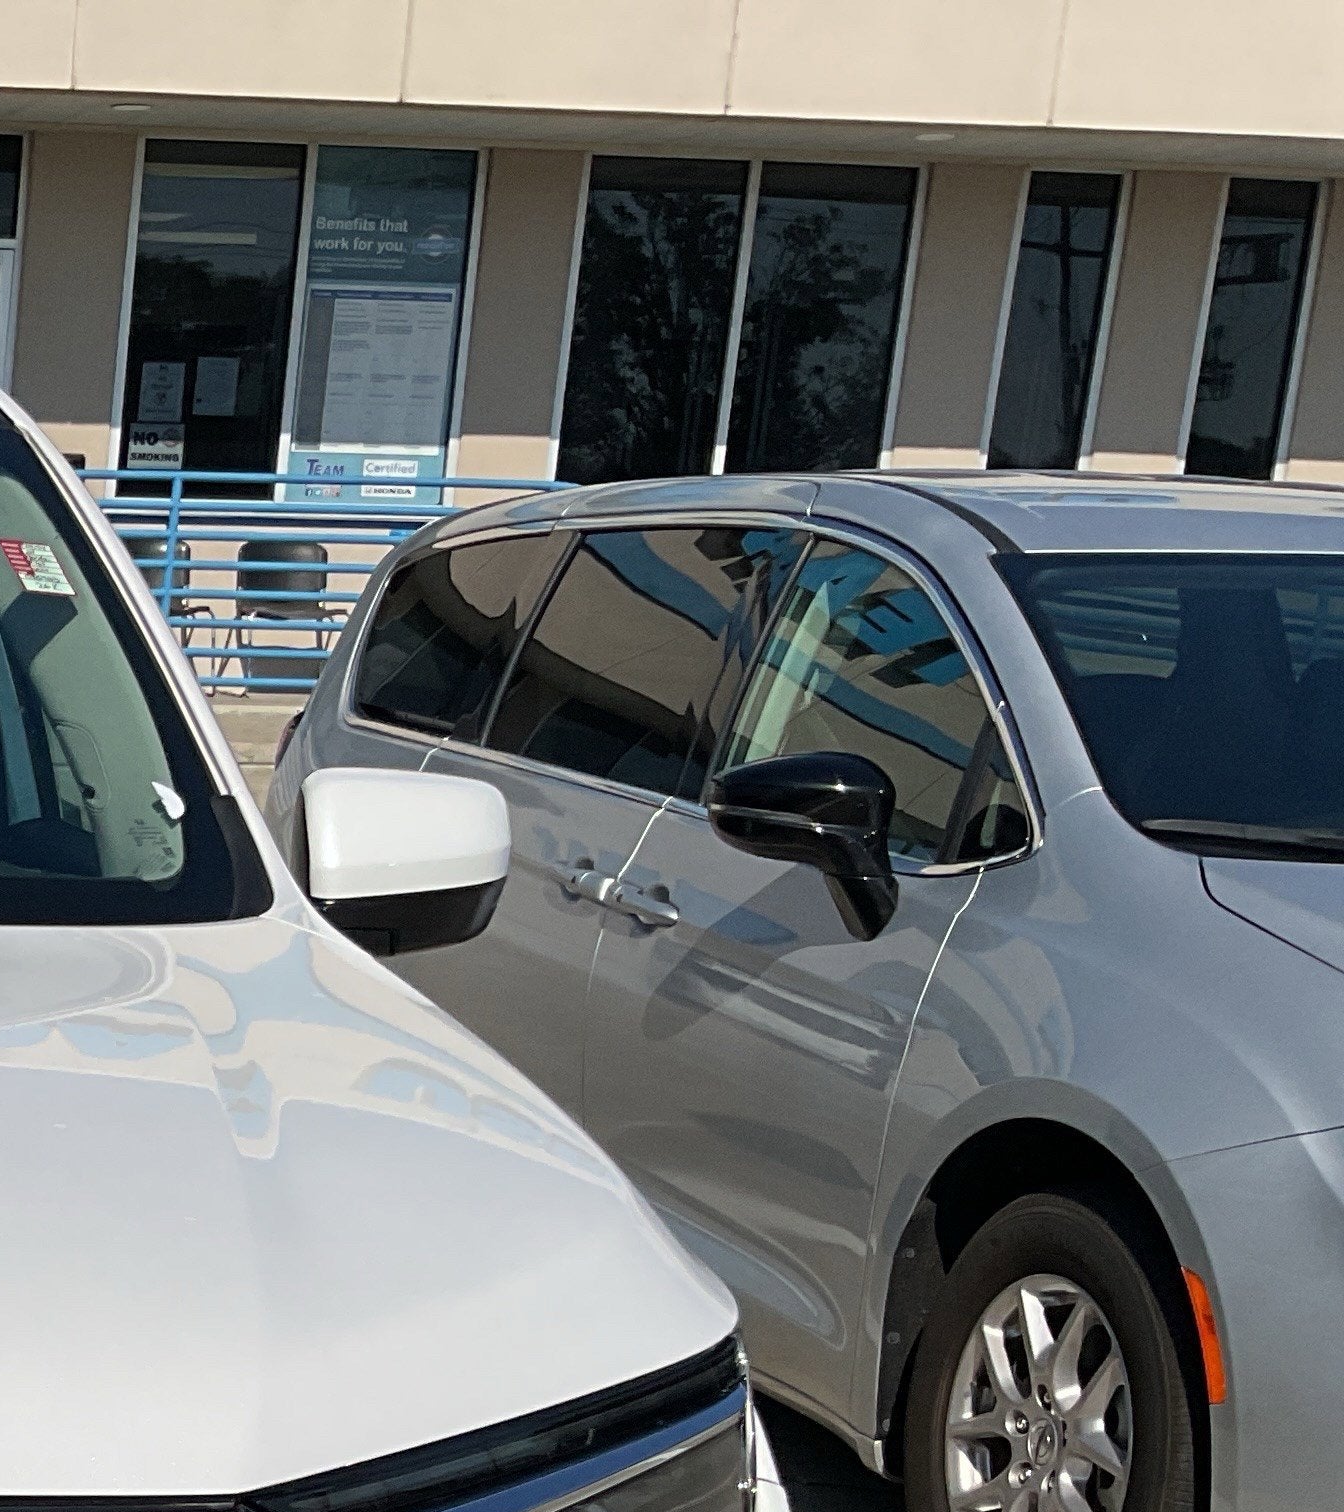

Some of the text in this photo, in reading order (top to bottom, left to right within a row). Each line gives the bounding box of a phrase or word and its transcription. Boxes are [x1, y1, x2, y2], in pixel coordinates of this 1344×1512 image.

[315, 216, 408, 233] Benefits that
[314, 237, 349, 250] work
[353, 236, 374, 251] for
[133, 431, 159, 446] NO
[130, 453, 179, 462] SMOKING
[365, 462, 416, 474] Certified
